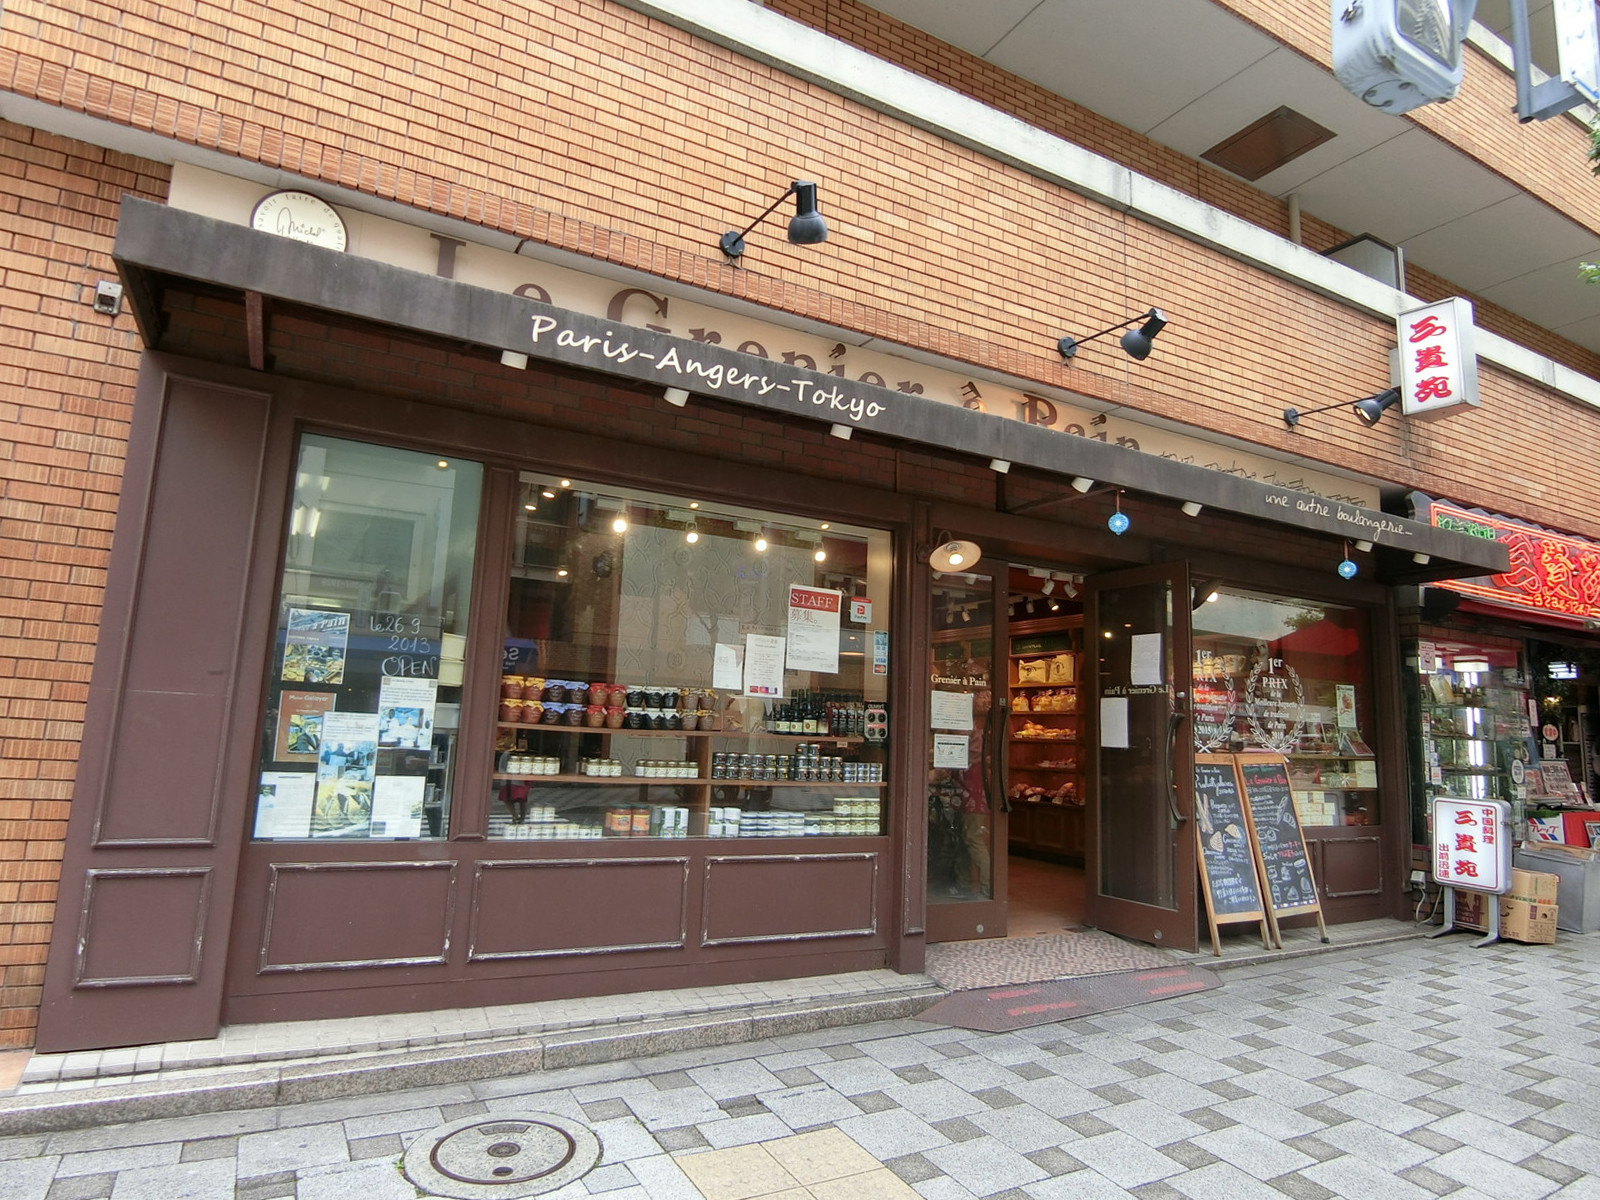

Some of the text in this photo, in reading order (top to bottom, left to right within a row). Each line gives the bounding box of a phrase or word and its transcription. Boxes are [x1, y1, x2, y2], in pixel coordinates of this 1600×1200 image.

[531, 314, 886, 422] Paris-Angers-Tokyo
[1265, 494, 1290, 507] une
[1296, 497, 1331, 517] autre
[791, 592, 834, 609] STAFF
[386, 616, 405, 634] 26
[411, 618, 421, 635] 9
[387, 635, 431, 654] 2013
[381, 655, 437, 677] OPEN
[1268, 657, 1283, 674] 1er
[931, 673, 961, 686] Grenier
[969, 676, 987, 687] Pain
[1262, 676, 1288, 690] PRIX
